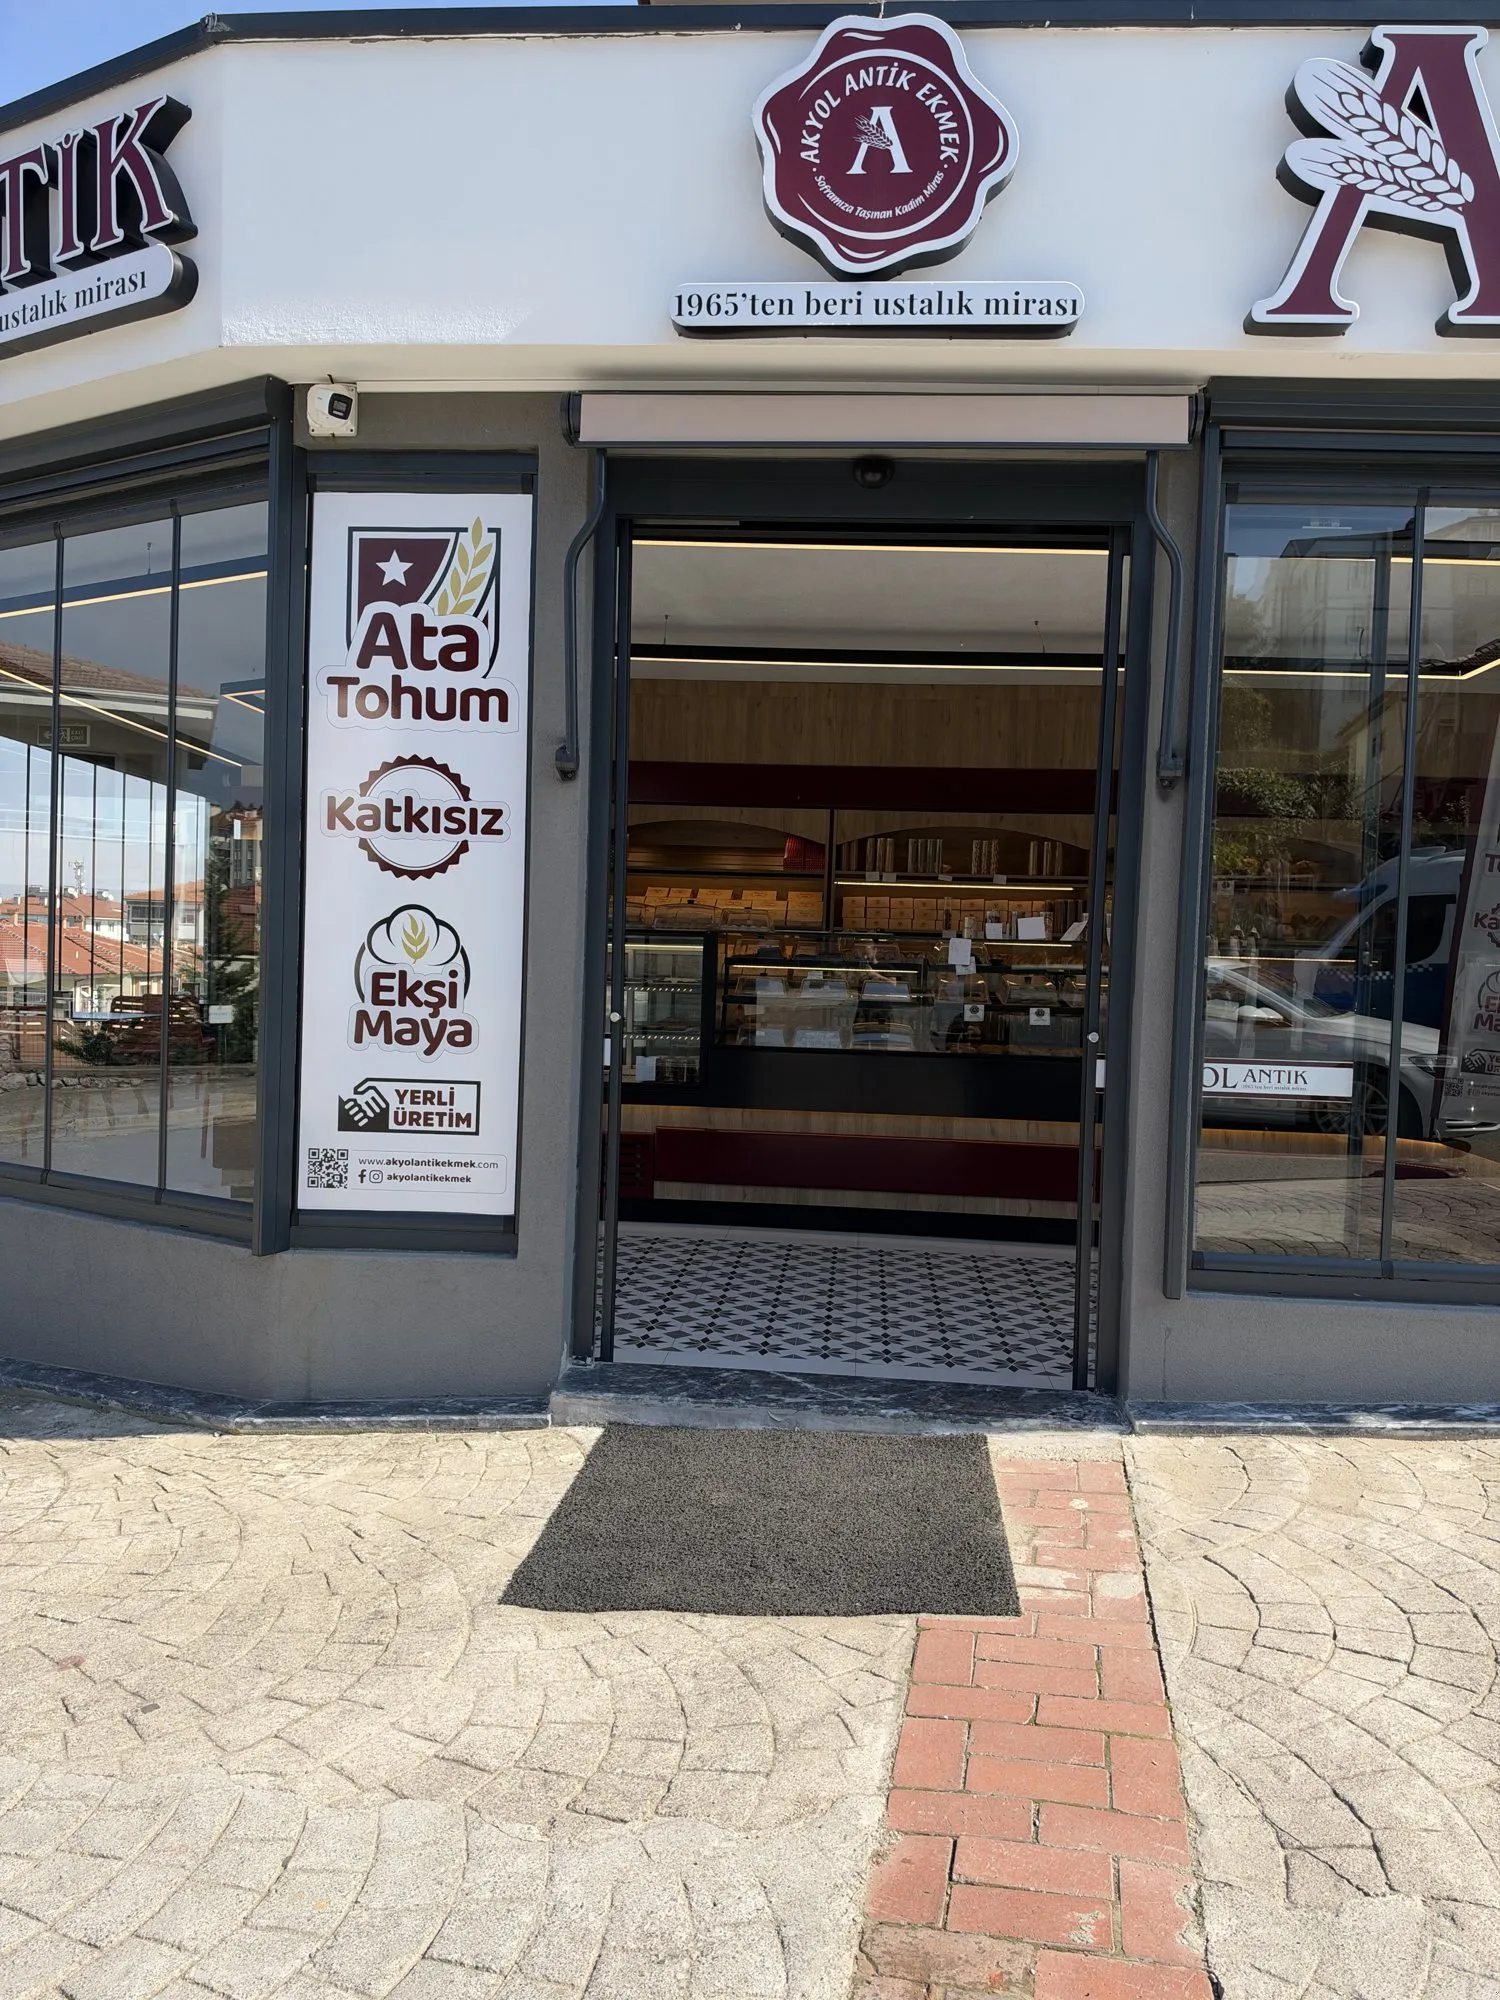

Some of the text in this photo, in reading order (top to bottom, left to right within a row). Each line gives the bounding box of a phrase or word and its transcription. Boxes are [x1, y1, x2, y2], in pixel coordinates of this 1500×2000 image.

[800, 62, 960, 164] AKYOL ANTİK EKMEK
[846, 106, 913, 175] A
[815, 175, 854, 213] Soframıza
[855, 207, 893, 219] Taşınan
[923, 170, 945, 198] Miras
[75, 269, 147, 309] mirası
[804, 291, 863, 316] beri
[873, 290, 974, 316] ustalık
[984, 291, 1079, 317] mirası
[356, 612, 480, 672] Ata
[326, 674, 509, 723] Tohum
[326, 794, 504, 836] Katkısız
[371, 969, 458, 1018] Ekşi
[353, 1009, 473, 1056] Maya
[394, 1087, 455, 1106] YERLİ
[1243, 1069, 1308, 1085] ANTIK
[393, 1107, 472, 1128] ÜRETİM
[358, 1157, 499, 1169] www.akyolantikekmek.com
[386, 1173, 472, 1184] akyolantikekmek
